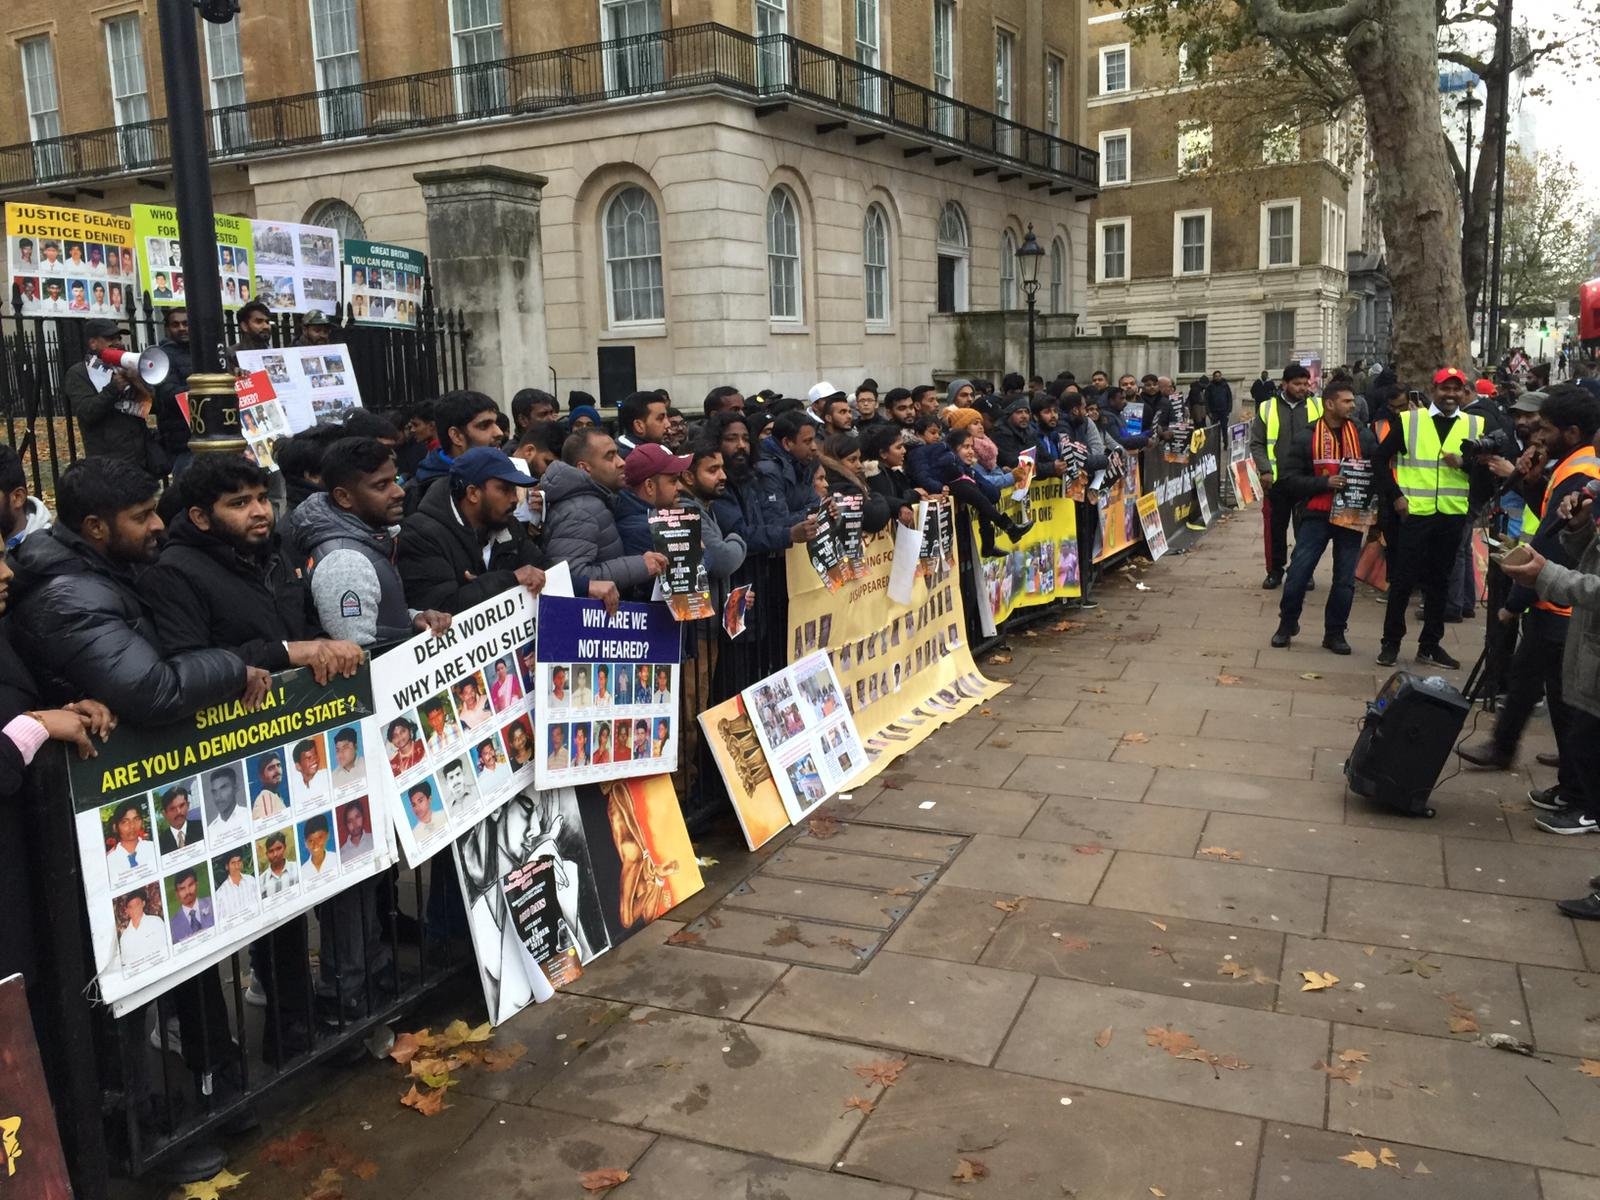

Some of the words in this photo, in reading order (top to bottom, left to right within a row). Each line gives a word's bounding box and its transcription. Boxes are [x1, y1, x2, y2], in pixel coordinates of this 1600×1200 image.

[17, 207, 80, 223] JUSTICE
[84, 214, 131, 231] DELAYED
[150, 209, 173, 221] WHO
[17, 224, 81, 239] JUSTICE
[85, 230, 125, 245] DENIED
[158, 225, 177, 237] FOR
[351, 255, 366, 265] YOU
[367, 257, 381, 267] CAN
[381, 259, 395, 270] GIVE
[395, 261, 404, 270] US
[370, 245, 390, 257] GREAT
[390, 249, 410, 260] BRITAIN
[883, 550, 895, 563] FO
[582, 608, 607, 628] WHY
[608, 610, 630, 629] ARE
[631, 611, 648, 630] WE
[414, 627, 458, 665] DEAR
[458, 599, 515, 639] WORLD
[578, 639, 600, 658] NOT
[602, 639, 650, 659] HEARED?
[393, 675, 430, 711] WHY
[435, 656, 467, 689] ARE
[466, 639, 499, 668] YOU
[196, 689, 277, 729] SRILAA
[101, 762, 141, 793] ARE
[141, 750, 180, 778] YOU
[184, 745, 197, 766] A
[199, 710, 302, 761] DEMOCRATIC
[305, 698, 347, 726] STATE
